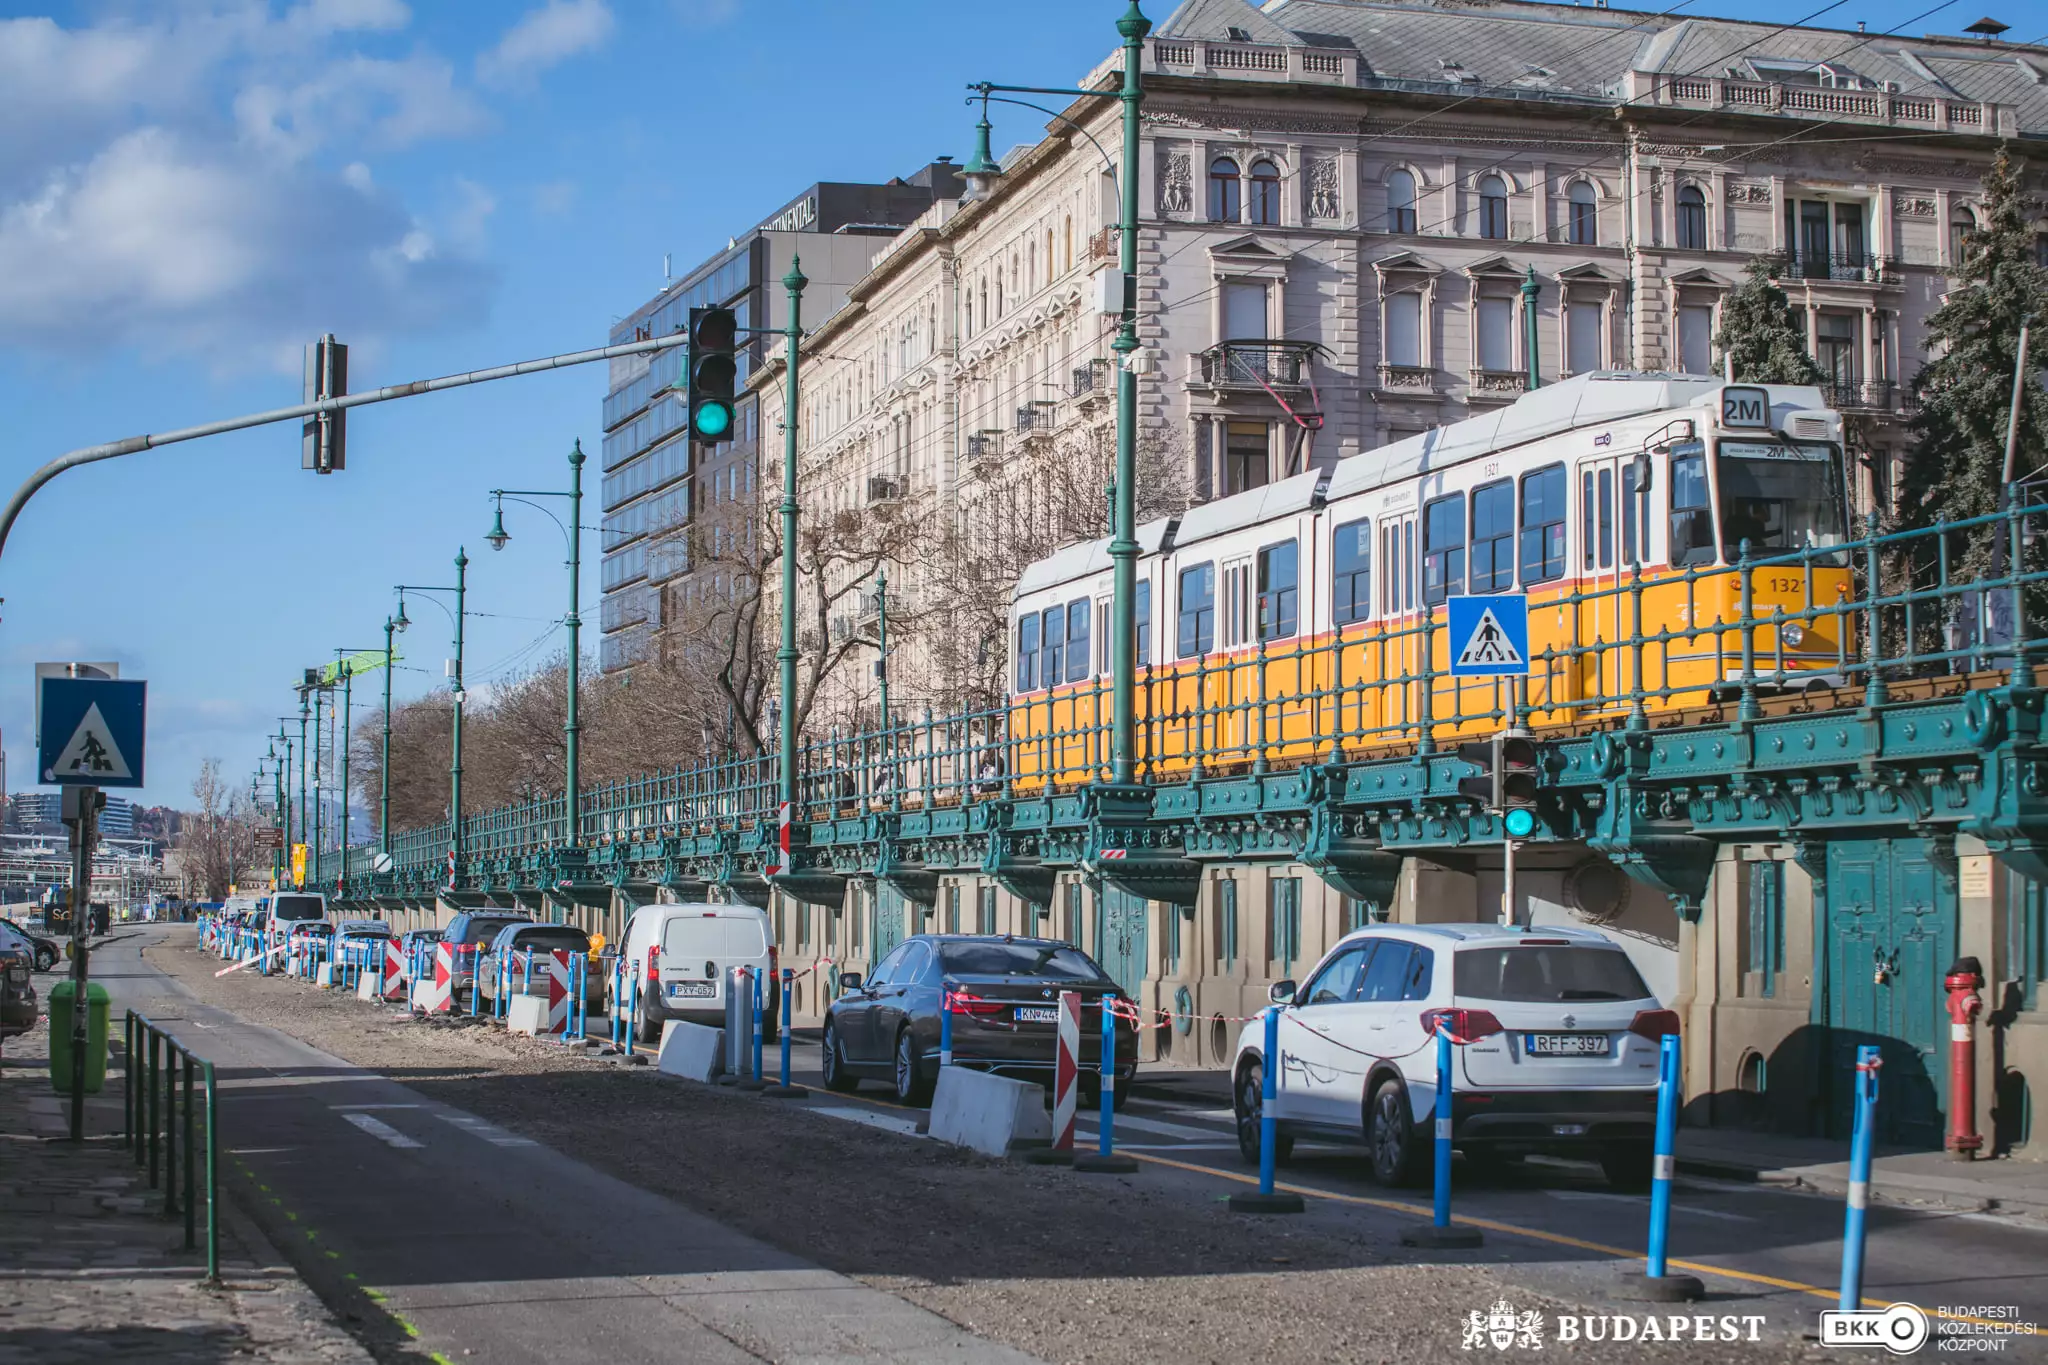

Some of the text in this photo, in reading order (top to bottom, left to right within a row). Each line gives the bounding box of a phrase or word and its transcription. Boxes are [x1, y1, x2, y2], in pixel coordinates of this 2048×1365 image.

[1724, 400, 1761, 420] 2M
[1766, 446, 1785, 458] 2M
[1485, 462, 1499, 478] 1321
[1770, 578, 1806, 593] 132
[1537, 1036, 1603, 1051] RFF-397
